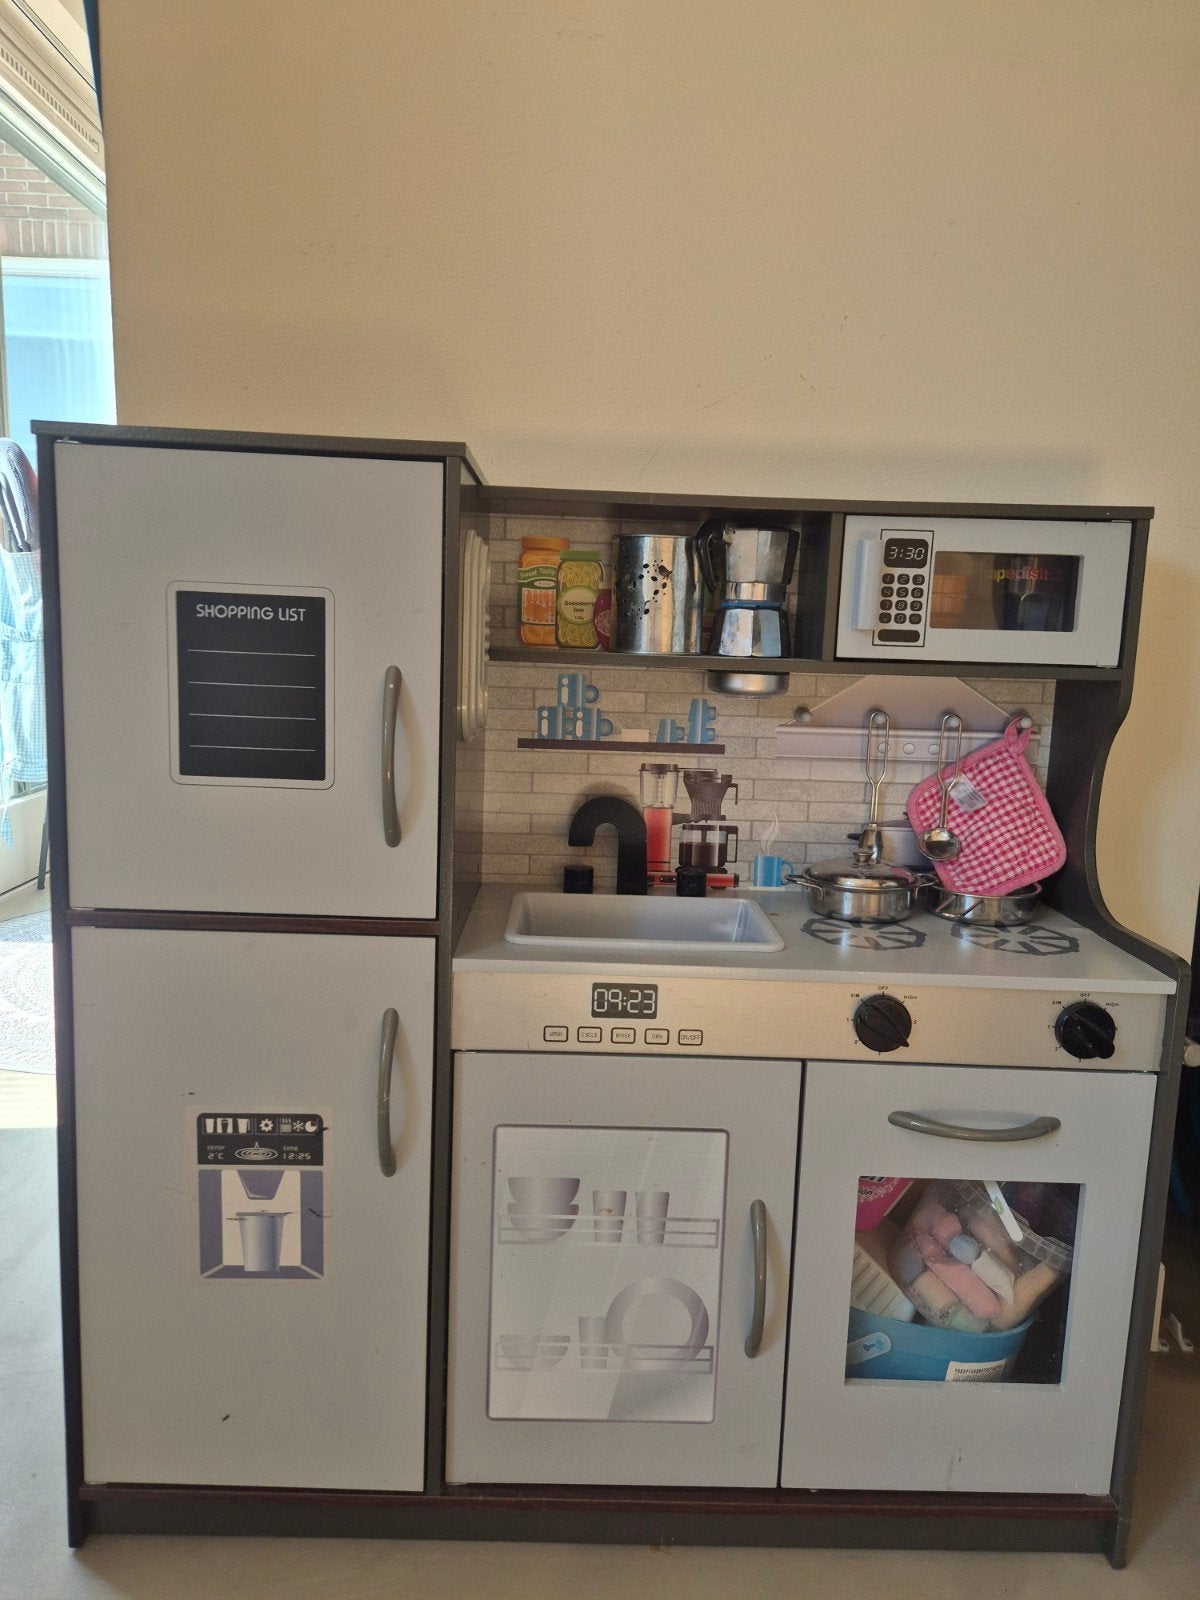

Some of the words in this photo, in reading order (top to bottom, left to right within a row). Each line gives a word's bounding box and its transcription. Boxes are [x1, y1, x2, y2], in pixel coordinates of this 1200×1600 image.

[888, 546, 925, 560] 3:30
[519, 570, 538, 579] Sweet
[539, 568, 556, 576] Tasty
[900, 575, 907, 583] 2
[899, 588, 906, 596] 5
[914, 589, 921, 597] 6
[898, 601, 905, 609] 8
[913, 602, 921, 610] 9
[196, 603, 274, 620] SHOPPING
[278, 607, 306, 622] LIST
[594, 989, 656, 1013] 09:23
[283, 1152, 312, 1160] 12:25
